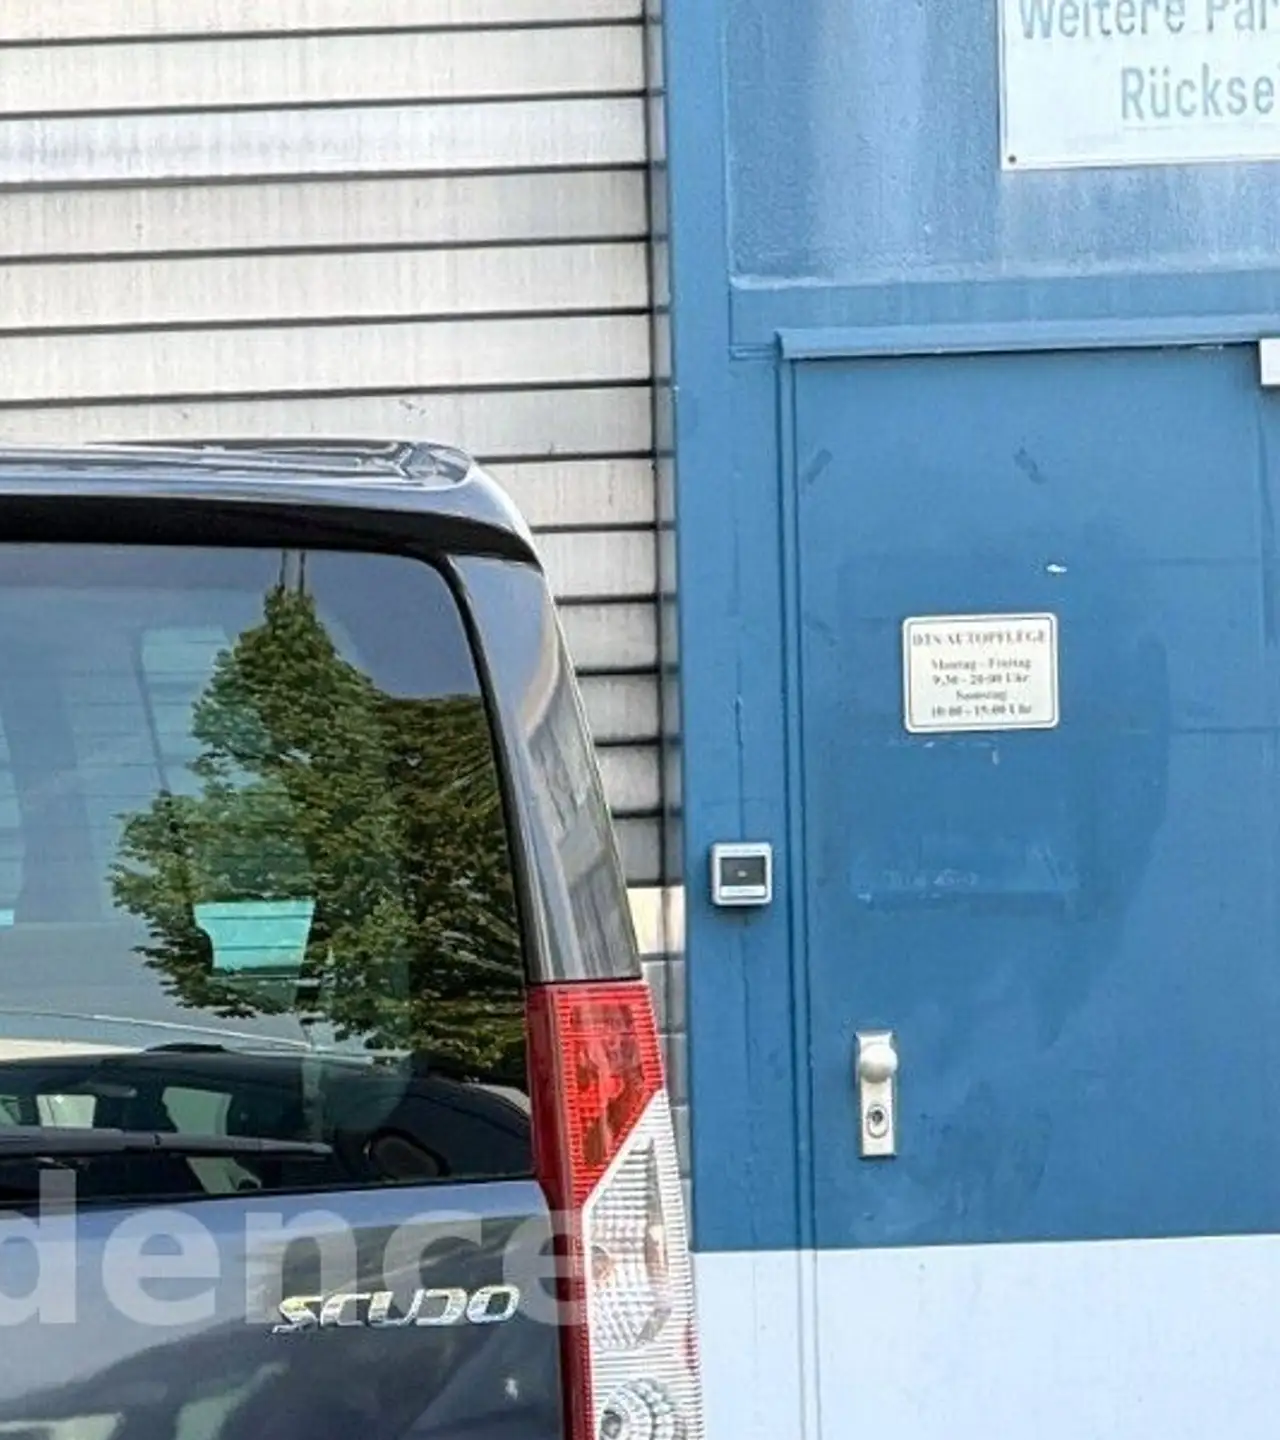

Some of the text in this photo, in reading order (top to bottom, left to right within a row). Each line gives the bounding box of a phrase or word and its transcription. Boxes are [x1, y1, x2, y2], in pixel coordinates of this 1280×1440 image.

[1020, 0, 1186, 39] Weitere
[1120, 62, 1280, 120] Rückse
[271, 1284, 520, 1334] SCUDO
